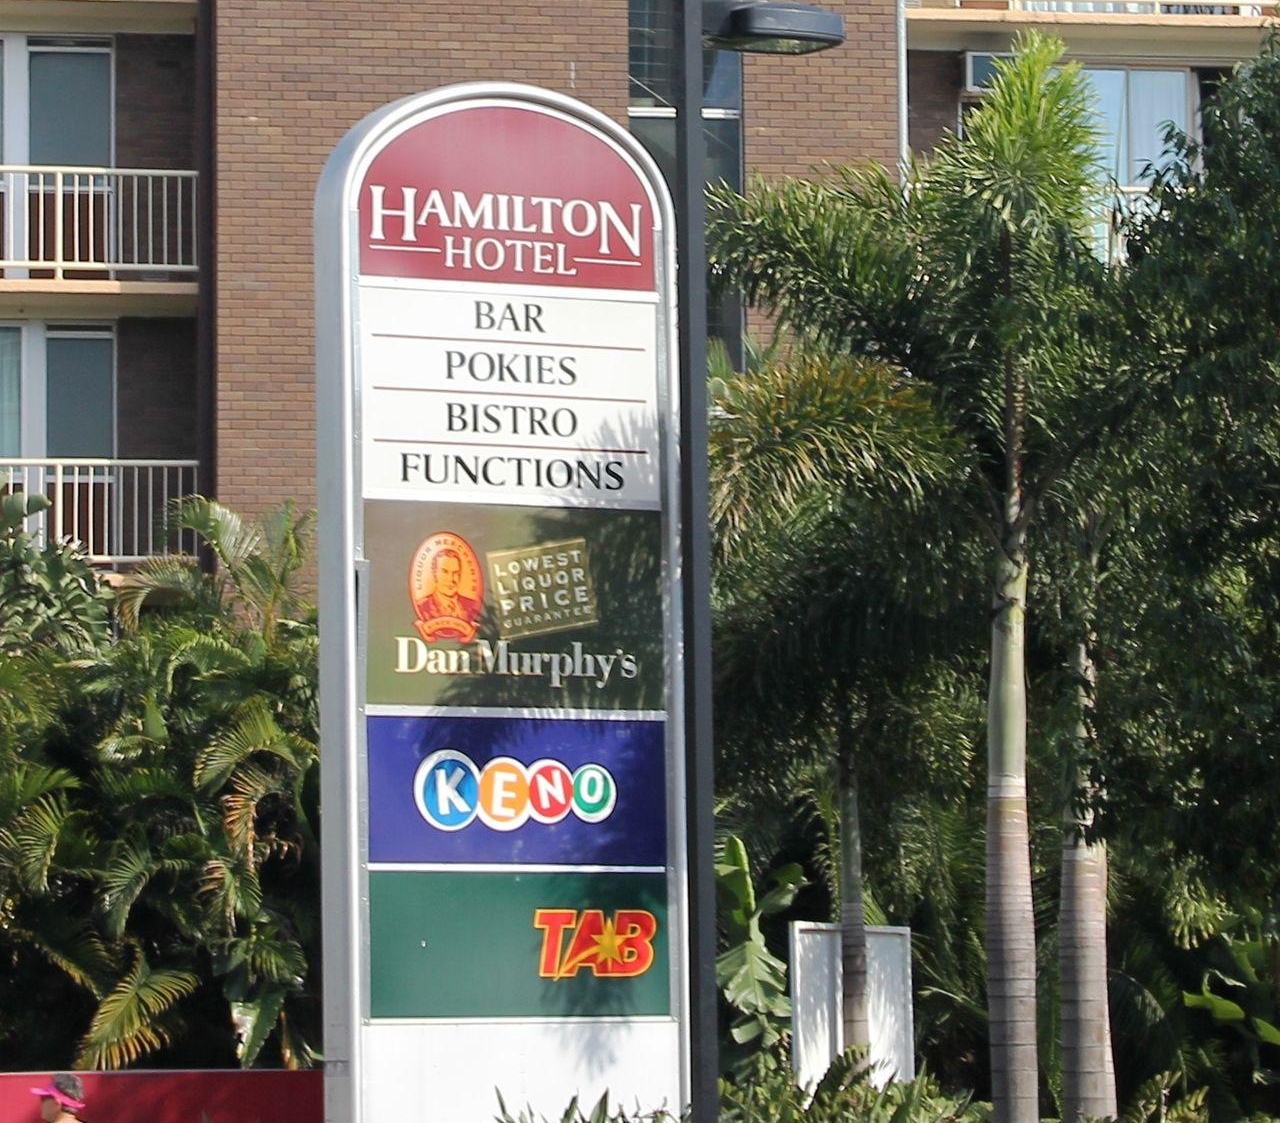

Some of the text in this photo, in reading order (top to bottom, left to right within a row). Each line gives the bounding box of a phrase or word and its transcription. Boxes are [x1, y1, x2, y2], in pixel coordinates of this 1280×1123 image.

[369, 184, 642, 258] HAMILTON
[444, 235, 578, 276] HOTEL
[474, 300, 546, 334] BAR
[445, 350, 578, 387] POKIES
[445, 402, 578, 438] BISTRO
[401, 452, 625, 491] FUNCTIONS
[493, 549, 582, 578] LOWEST
[496, 567, 585, 596] LIQUOR
[500, 585, 590, 616] PRICE
[502, 605, 592, 629] GUARANTEE
[394, 636, 472, 675] Dan
[431, 764, 608, 821] KENO
[532, 908, 657, 982] TAB
